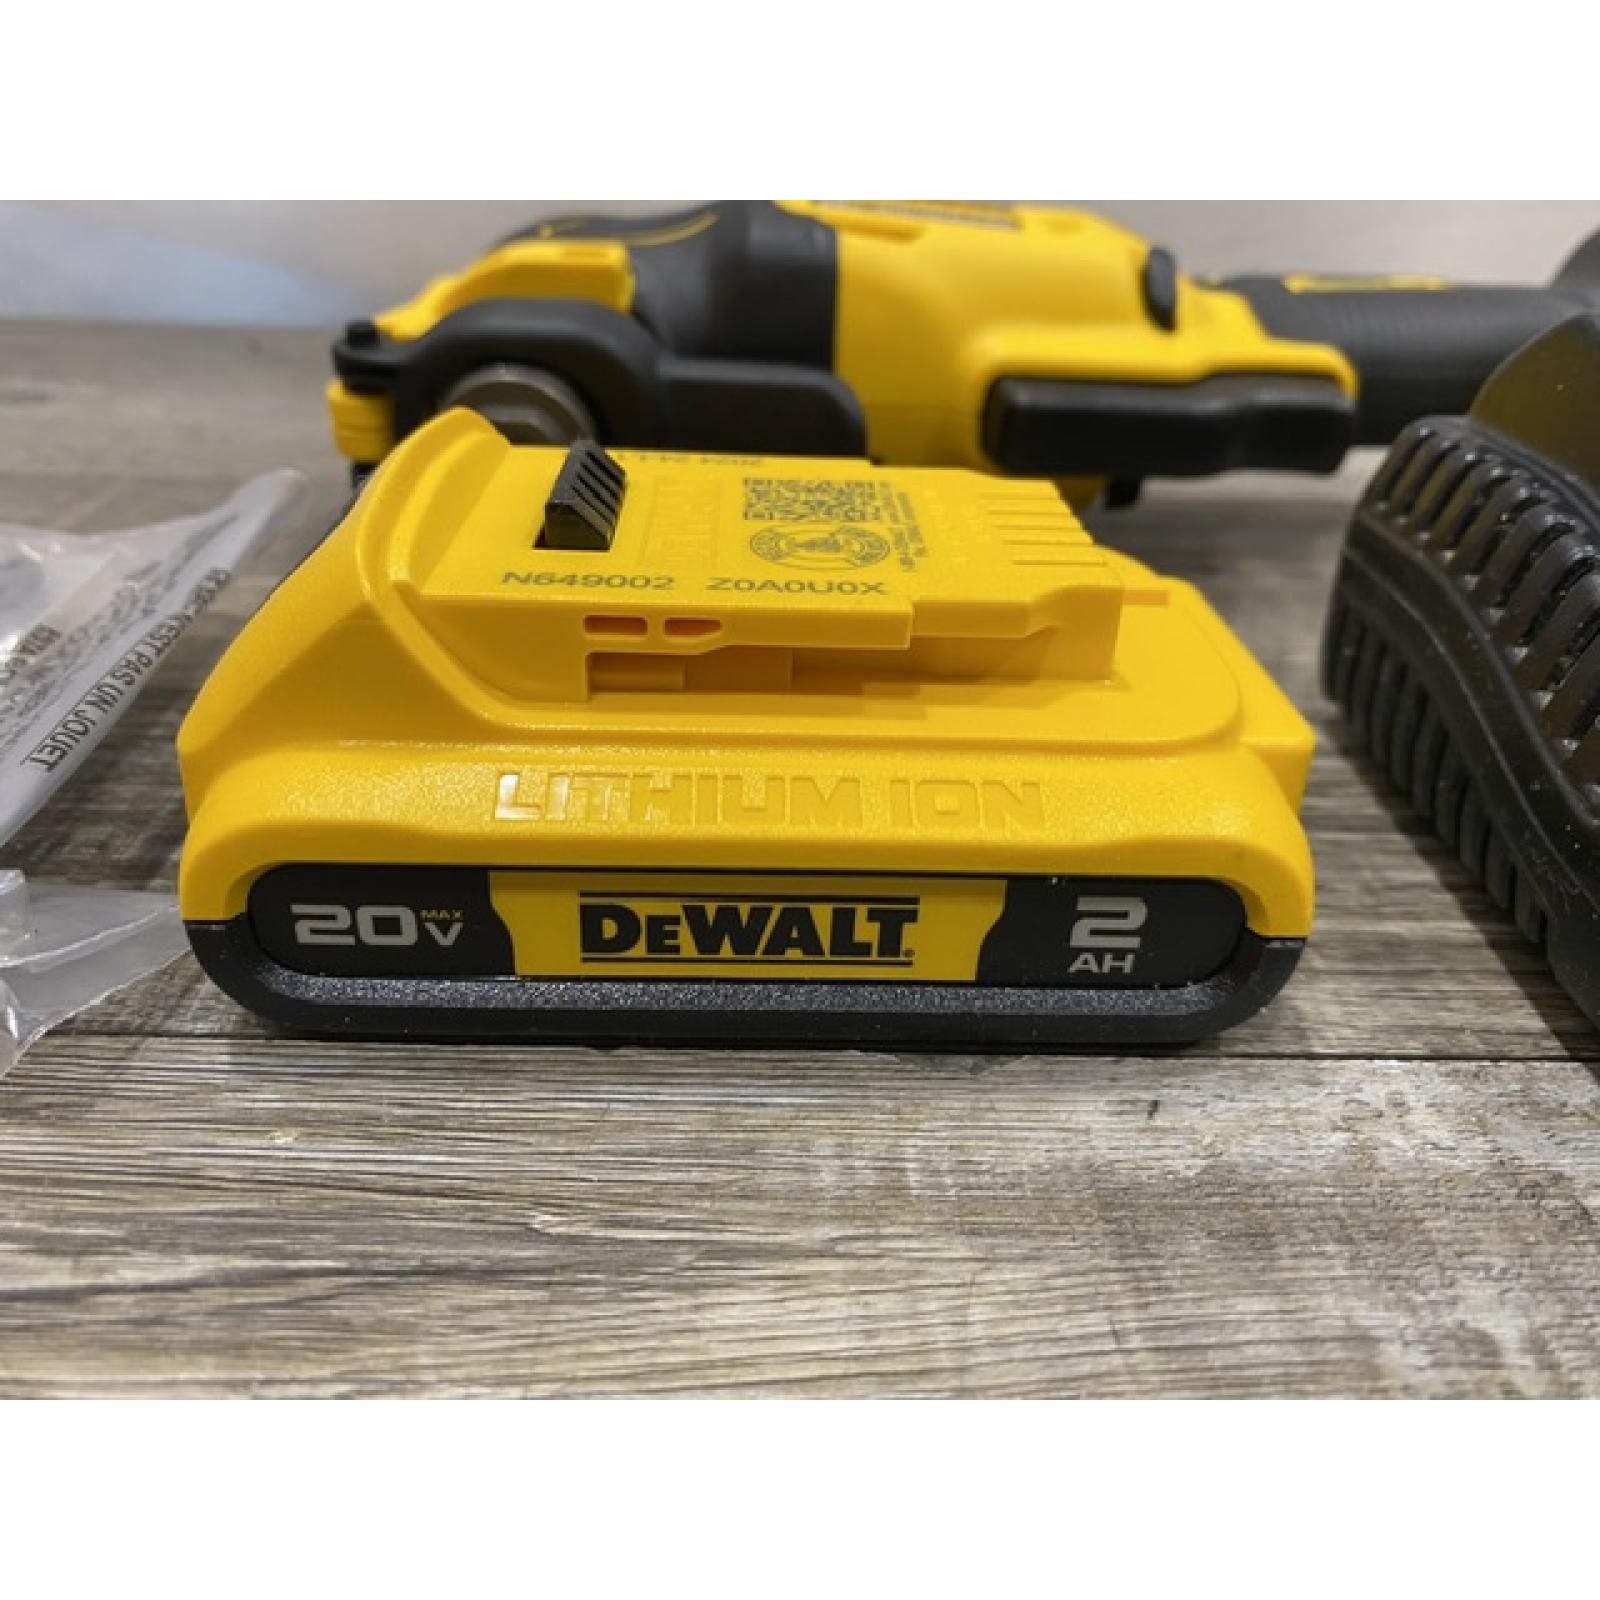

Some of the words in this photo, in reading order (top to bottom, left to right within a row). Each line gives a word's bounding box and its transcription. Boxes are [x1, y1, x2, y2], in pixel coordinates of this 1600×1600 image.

[502, 571, 675, 591] N649002
[28, 710, 97, 773] JOUET
[495, 772, 863, 827] LITHIUM
[890, 779, 1043, 829] ION
[421, 908, 464, 921] MAX
[1069, 896, 1148, 949] 2
[1067, 953, 1134, 974] AH
